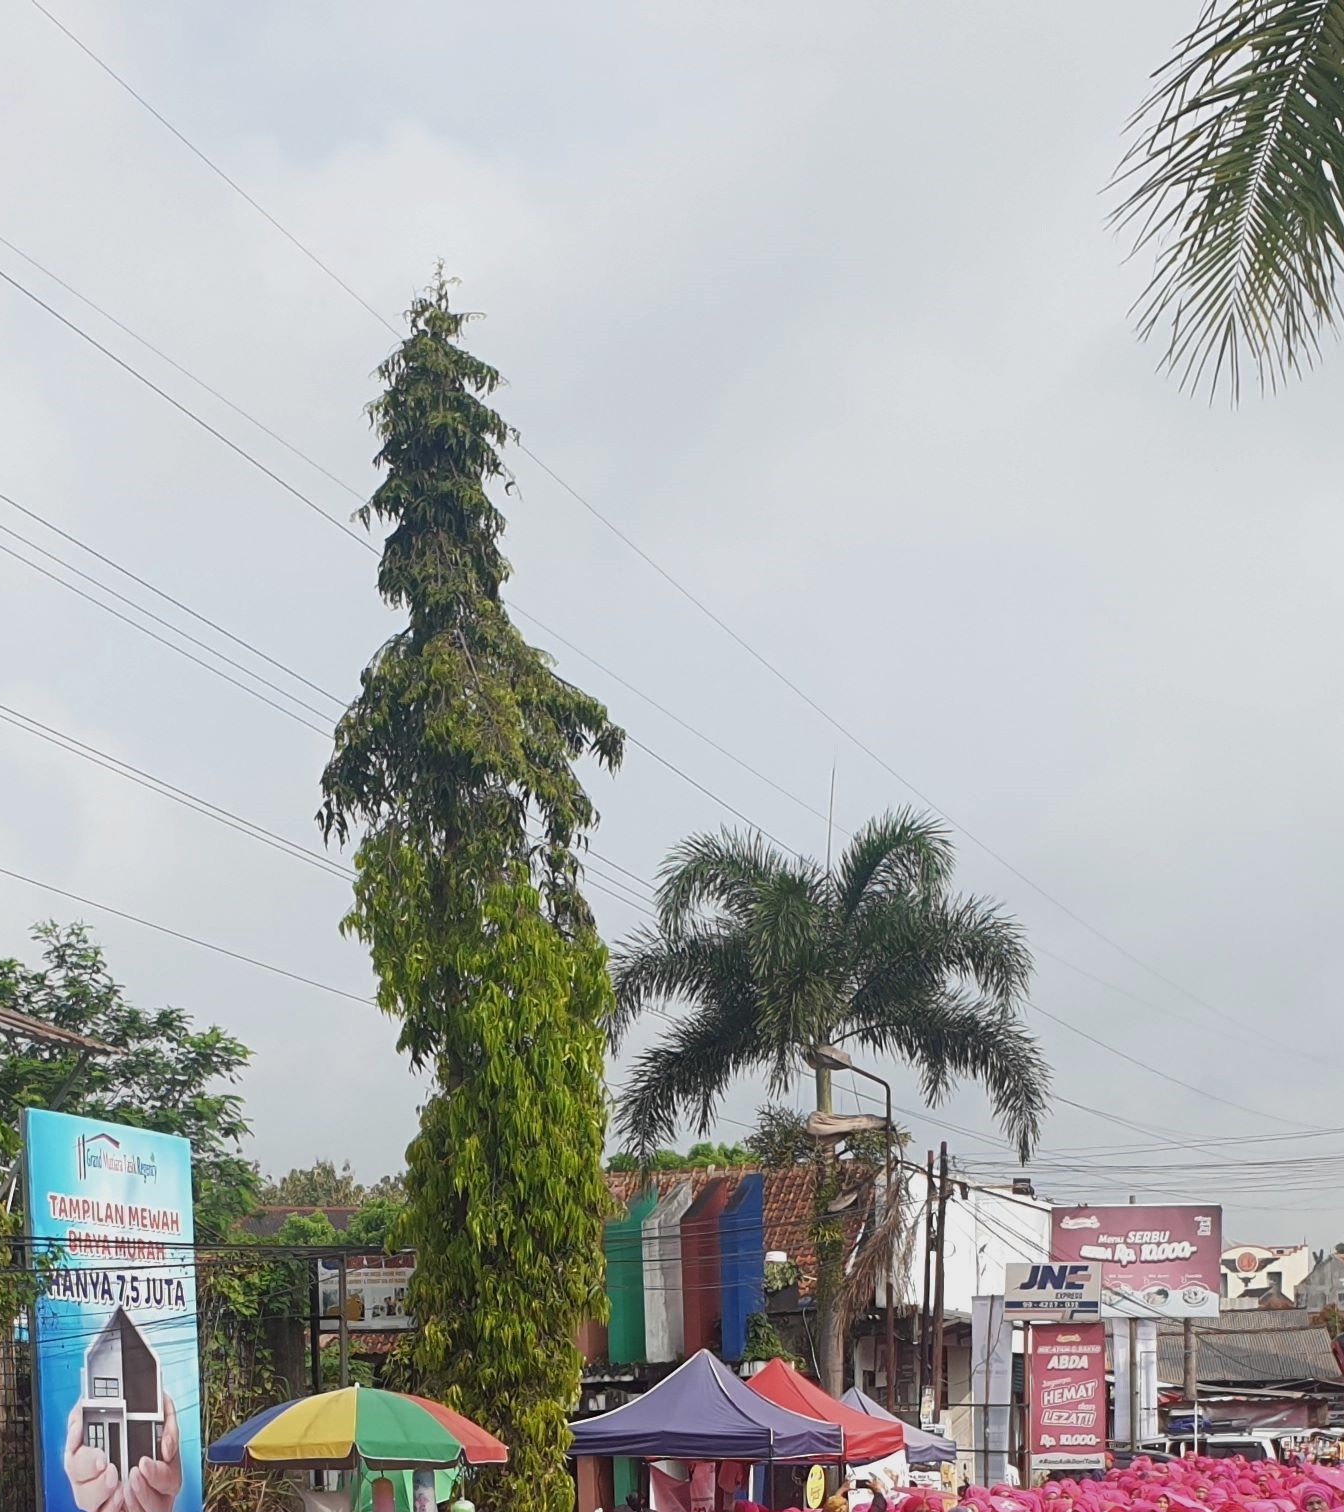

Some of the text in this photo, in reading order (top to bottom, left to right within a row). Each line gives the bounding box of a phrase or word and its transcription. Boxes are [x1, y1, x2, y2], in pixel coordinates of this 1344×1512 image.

[86, 1148, 102, 1169] Grand
[137, 1156, 157, 1184] Regency
[49, 1195, 180, 1233] TAMPILAN MEWAH
[68, 1230, 166, 1261] BIAYA MURAH
[1097, 1231, 1170, 1244] Menu SERBU
[48, 1269, 185, 1307] HANYA 7,5 JUTA
[1019, 1265, 1092, 1290] JNE
[1047, 1355, 1088, 1370] ABDA
[1043, 1382, 1096, 1406] HEMAT
